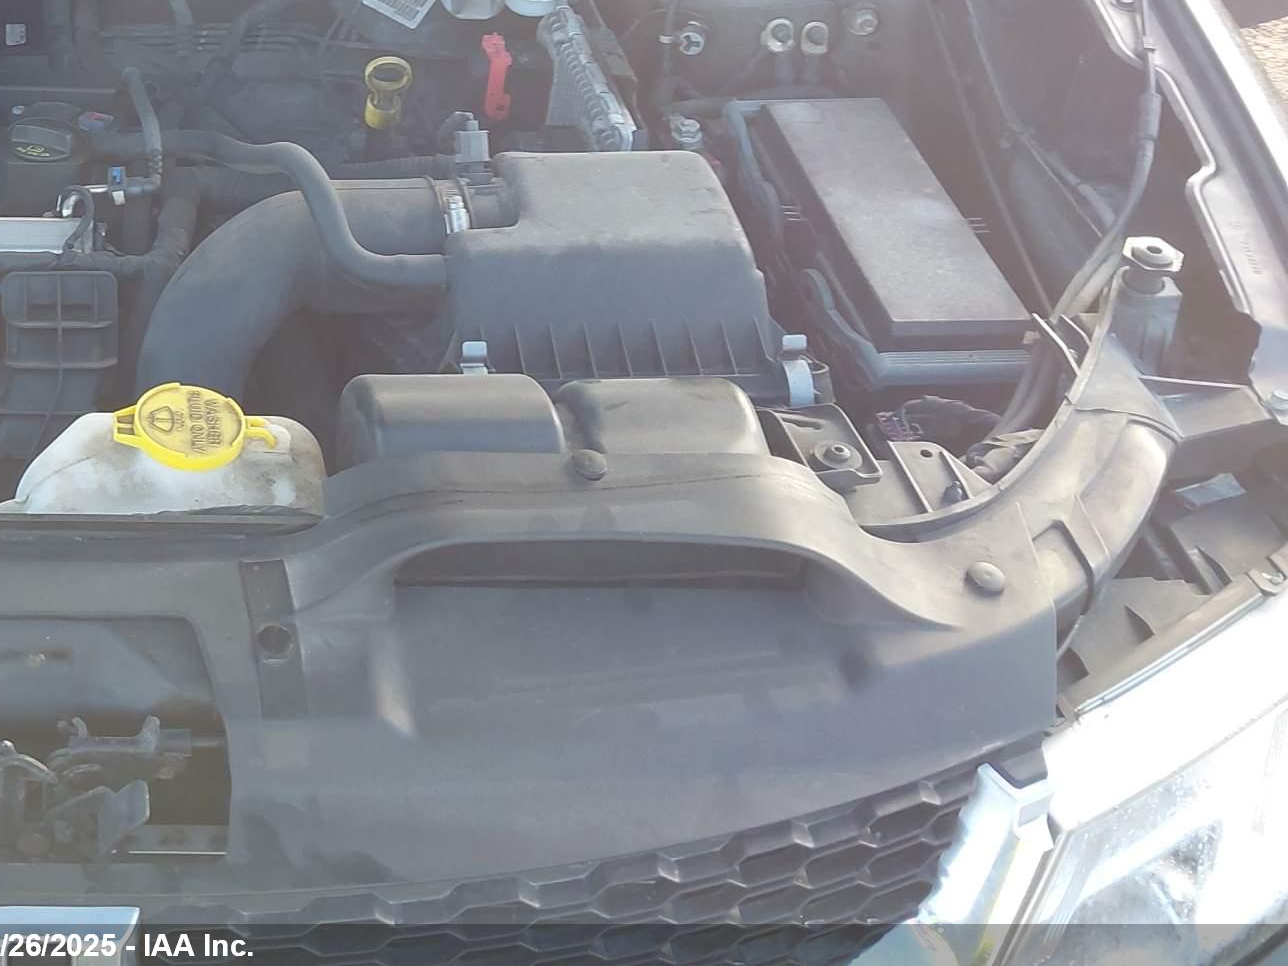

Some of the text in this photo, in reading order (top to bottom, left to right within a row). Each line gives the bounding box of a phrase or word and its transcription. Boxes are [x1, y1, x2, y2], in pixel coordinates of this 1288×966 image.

[187, 390, 207, 454] FLUID ONLY
[204, 398, 221, 447] WASHER
